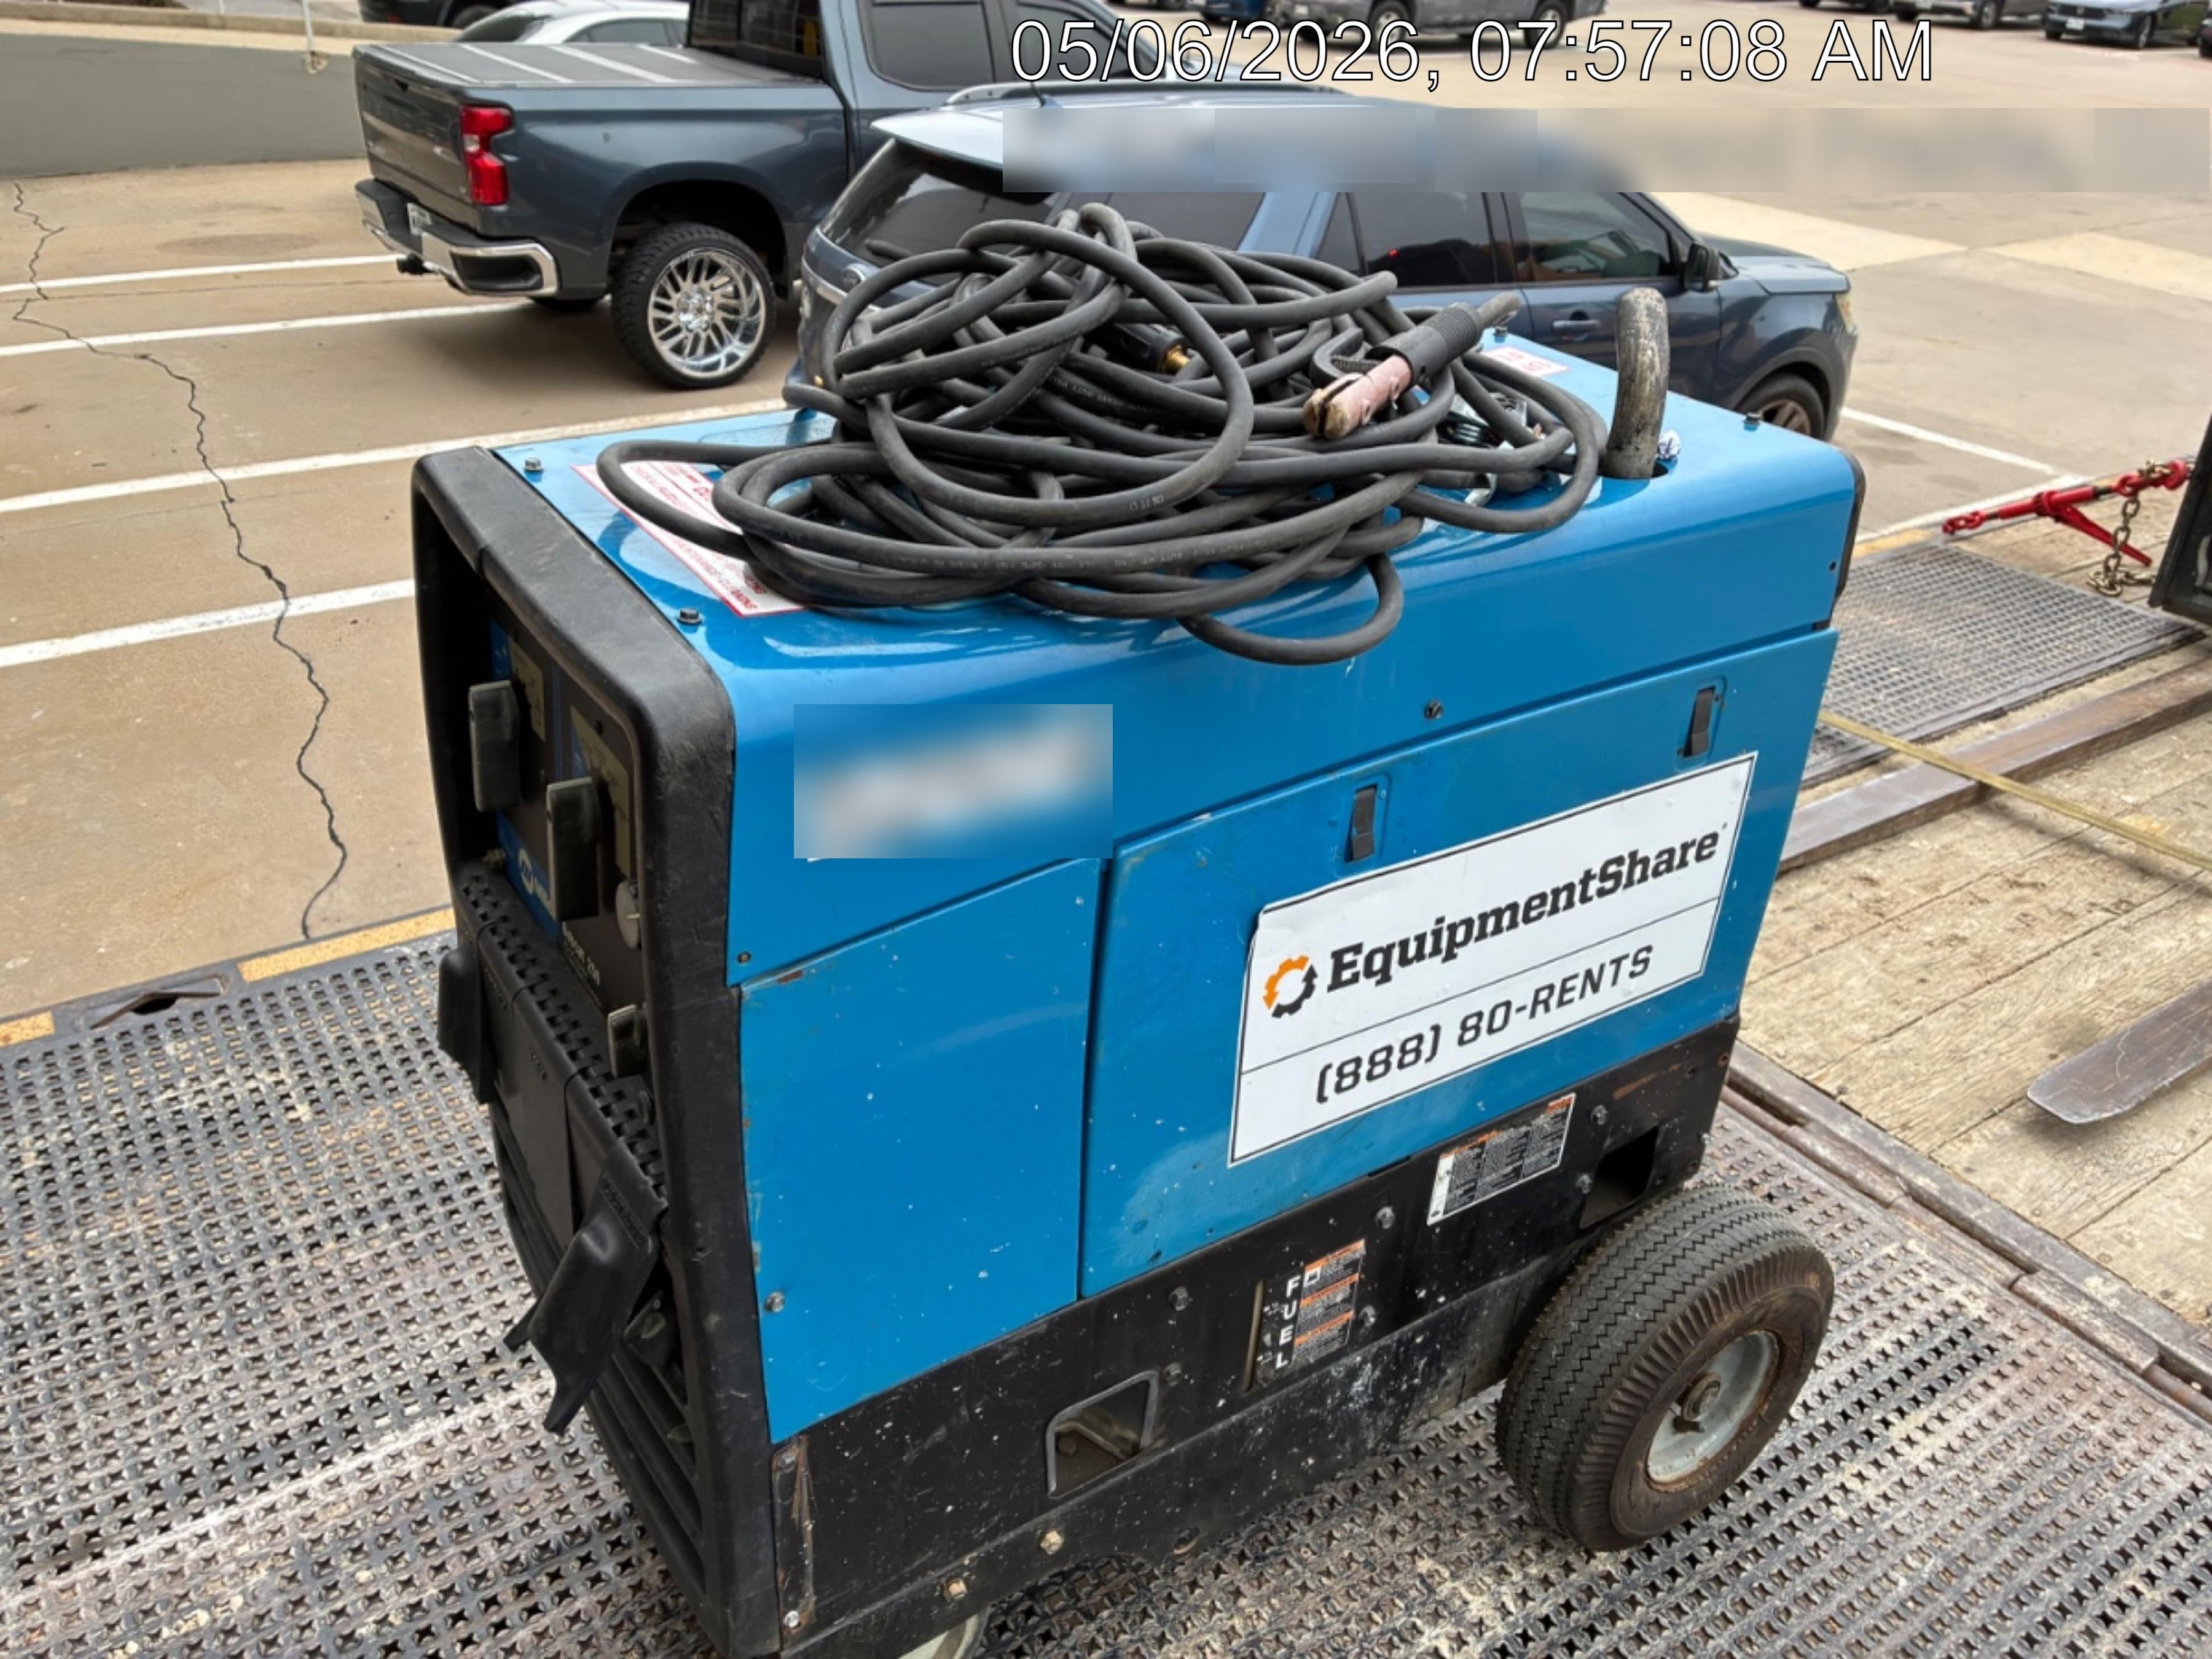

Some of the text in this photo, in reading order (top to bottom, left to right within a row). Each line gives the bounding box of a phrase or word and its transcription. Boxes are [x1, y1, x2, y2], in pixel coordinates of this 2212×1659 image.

[1327, 831, 1719, 993] EquipmentShare
[1316, 945, 1653, 1104] (888) 80-RENTS
[1275, 1275, 1301, 1370] FUEL
